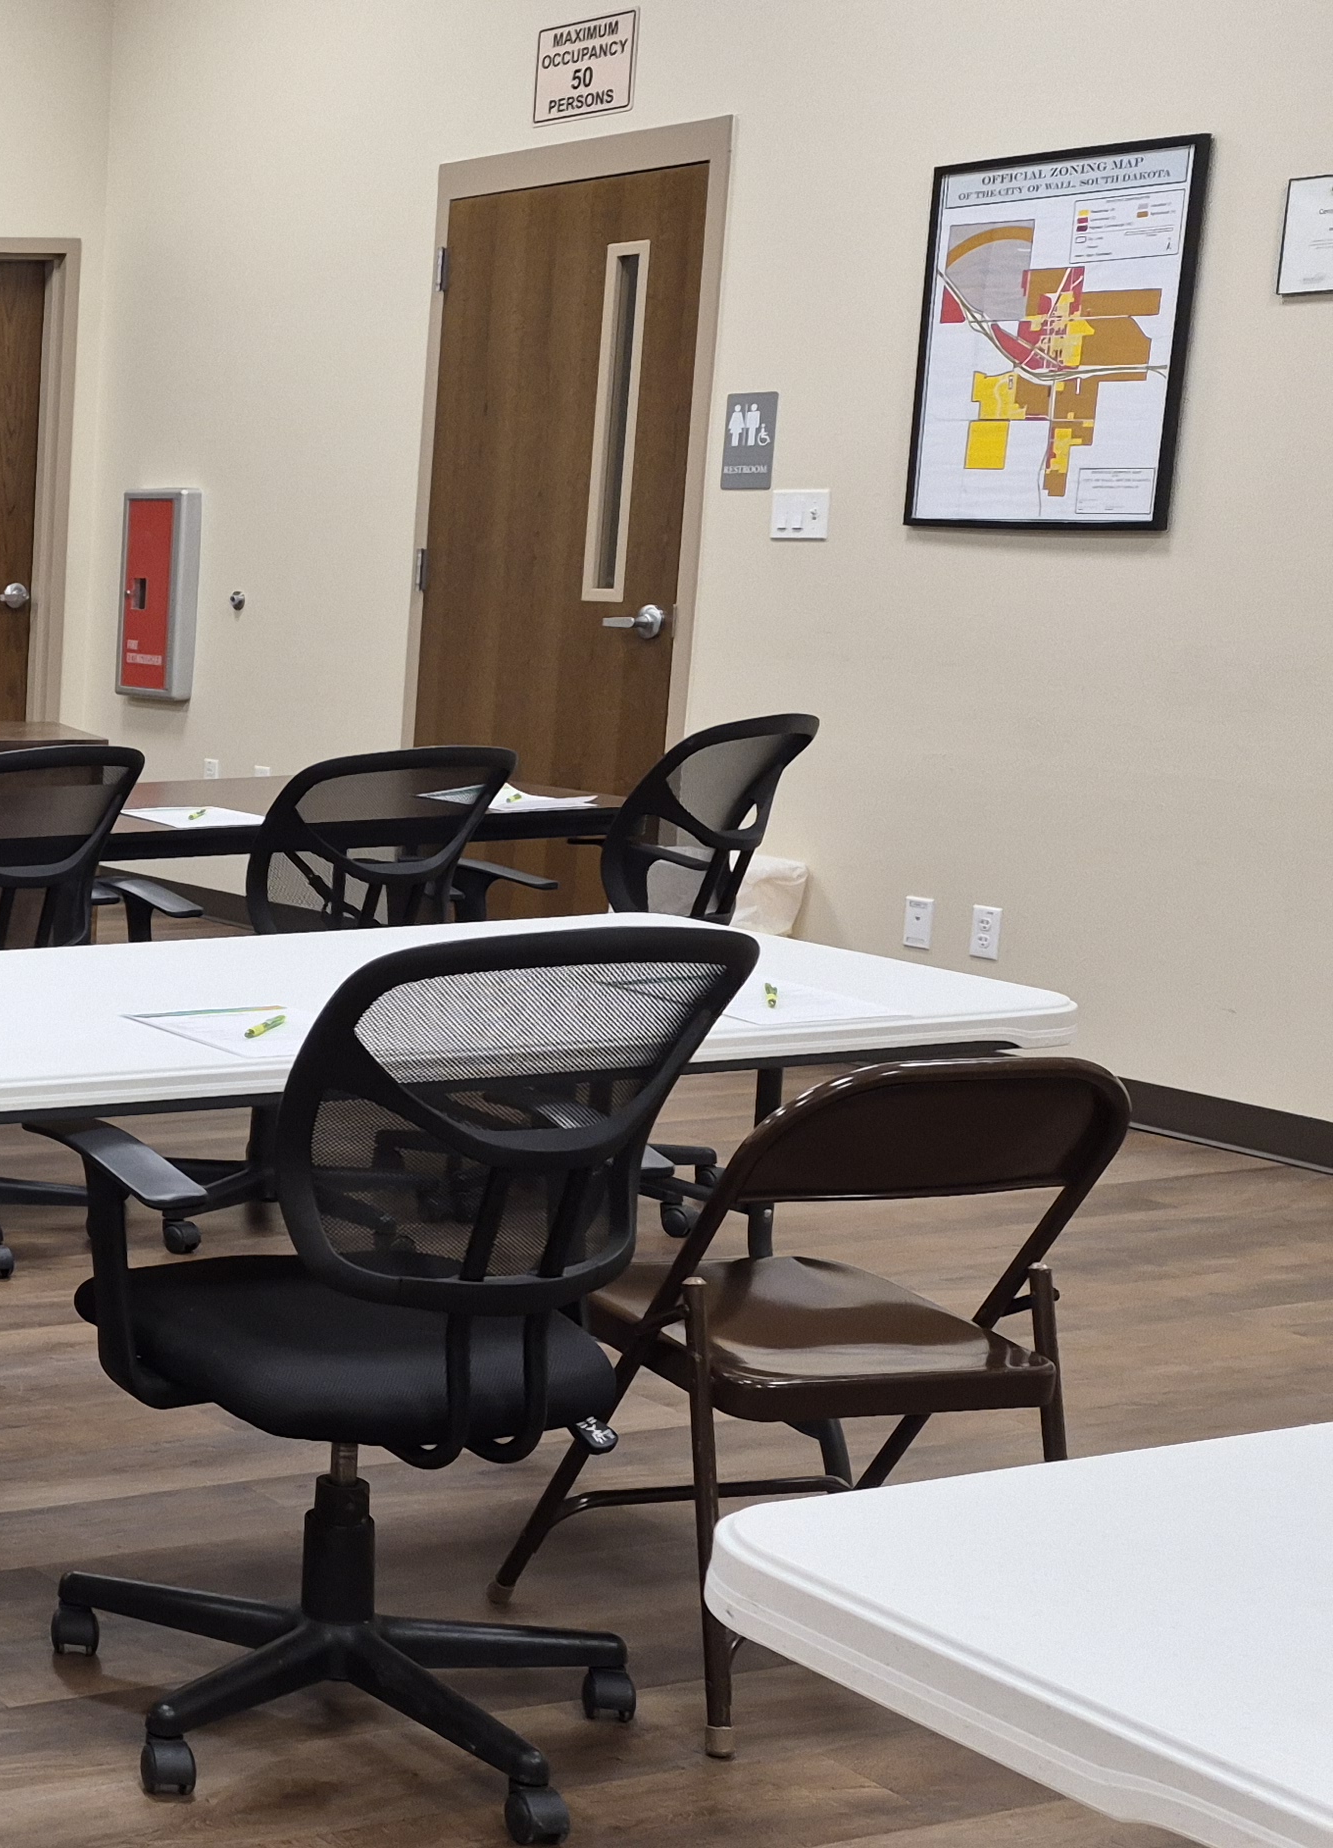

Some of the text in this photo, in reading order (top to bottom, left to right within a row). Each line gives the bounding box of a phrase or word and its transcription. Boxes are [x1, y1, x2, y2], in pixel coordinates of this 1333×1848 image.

[552, 20, 619, 48] MAXIMUM
[541, 38, 628, 69] OCCUPANCY
[571, 66, 593, 90] 50
[548, 89, 614, 114] PERSONS
[958, 192, 973, 201] OF
[974, 188, 996, 199] THE
[998, 186, 1023, 197] CITY
[1027, 183, 1042, 193] OF
[1079, 174, 1119, 187] SOUTH
[1122, 169, 1171, 183] DAKOTA
[981, 156, 1145, 186] OFFICIAL ZONING MAP
[723, 464, 768, 474] RESTROOM
